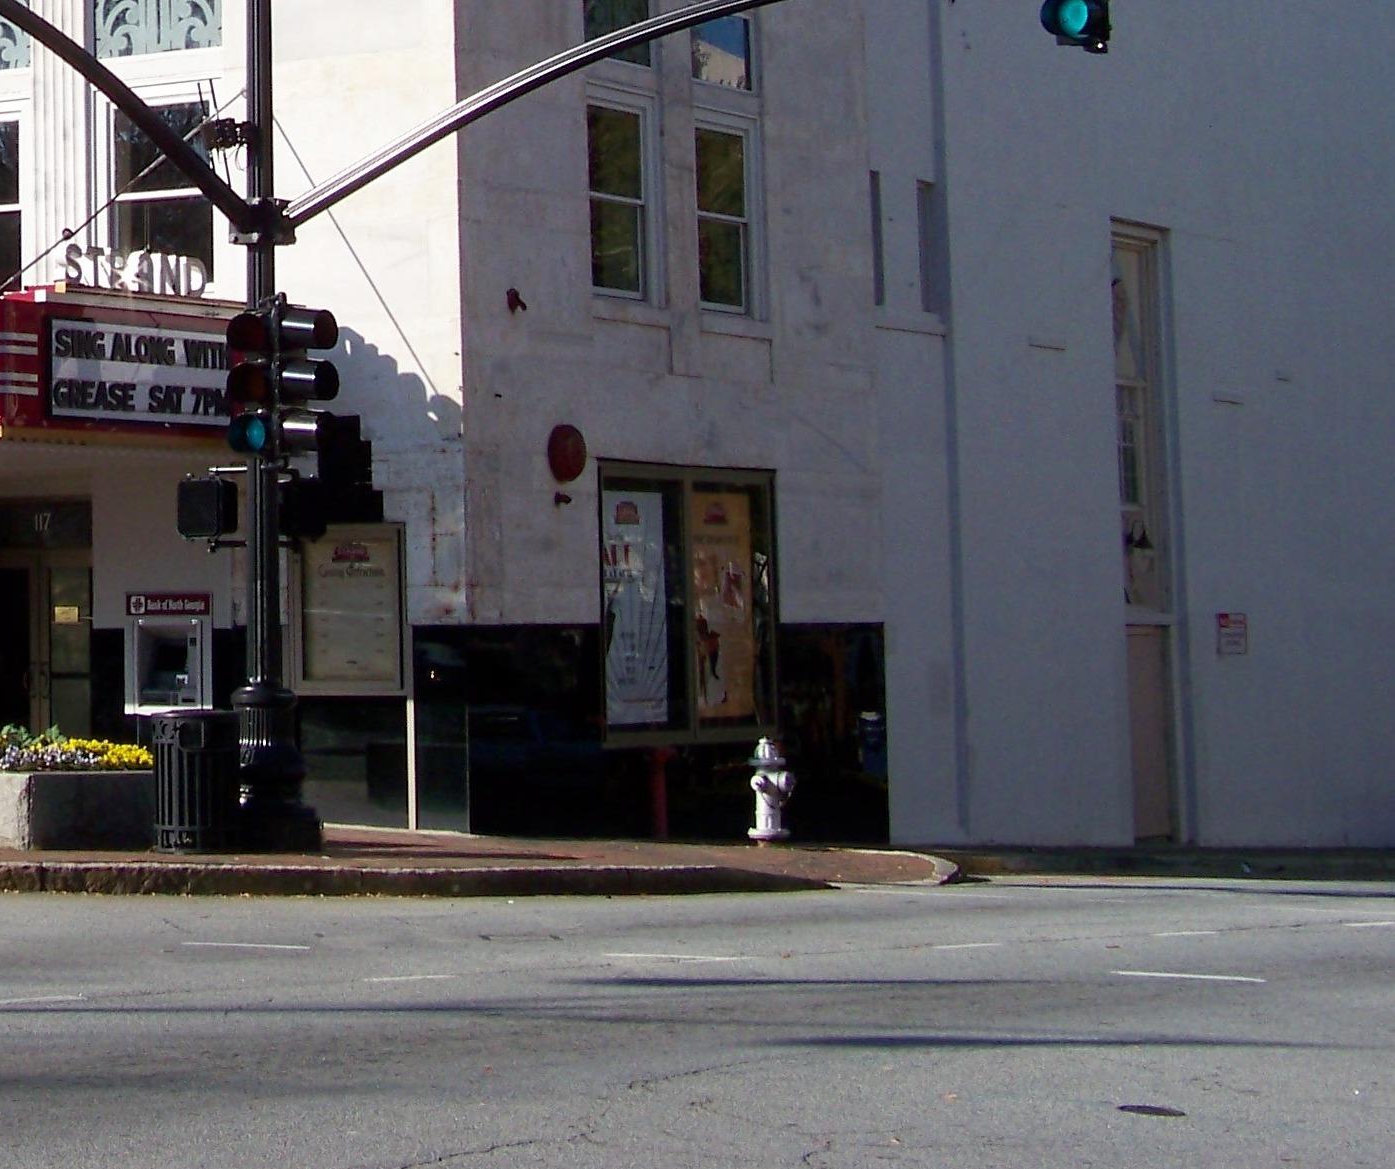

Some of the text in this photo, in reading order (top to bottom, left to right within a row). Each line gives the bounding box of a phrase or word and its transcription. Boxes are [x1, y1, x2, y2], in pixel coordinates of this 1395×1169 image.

[54, 328, 106, 360] SING
[111, 332, 176, 366] ALONG
[54, 378, 137, 412] GREASE
[149, 385, 186, 414] SAT
[35, 512, 51, 531] 117
